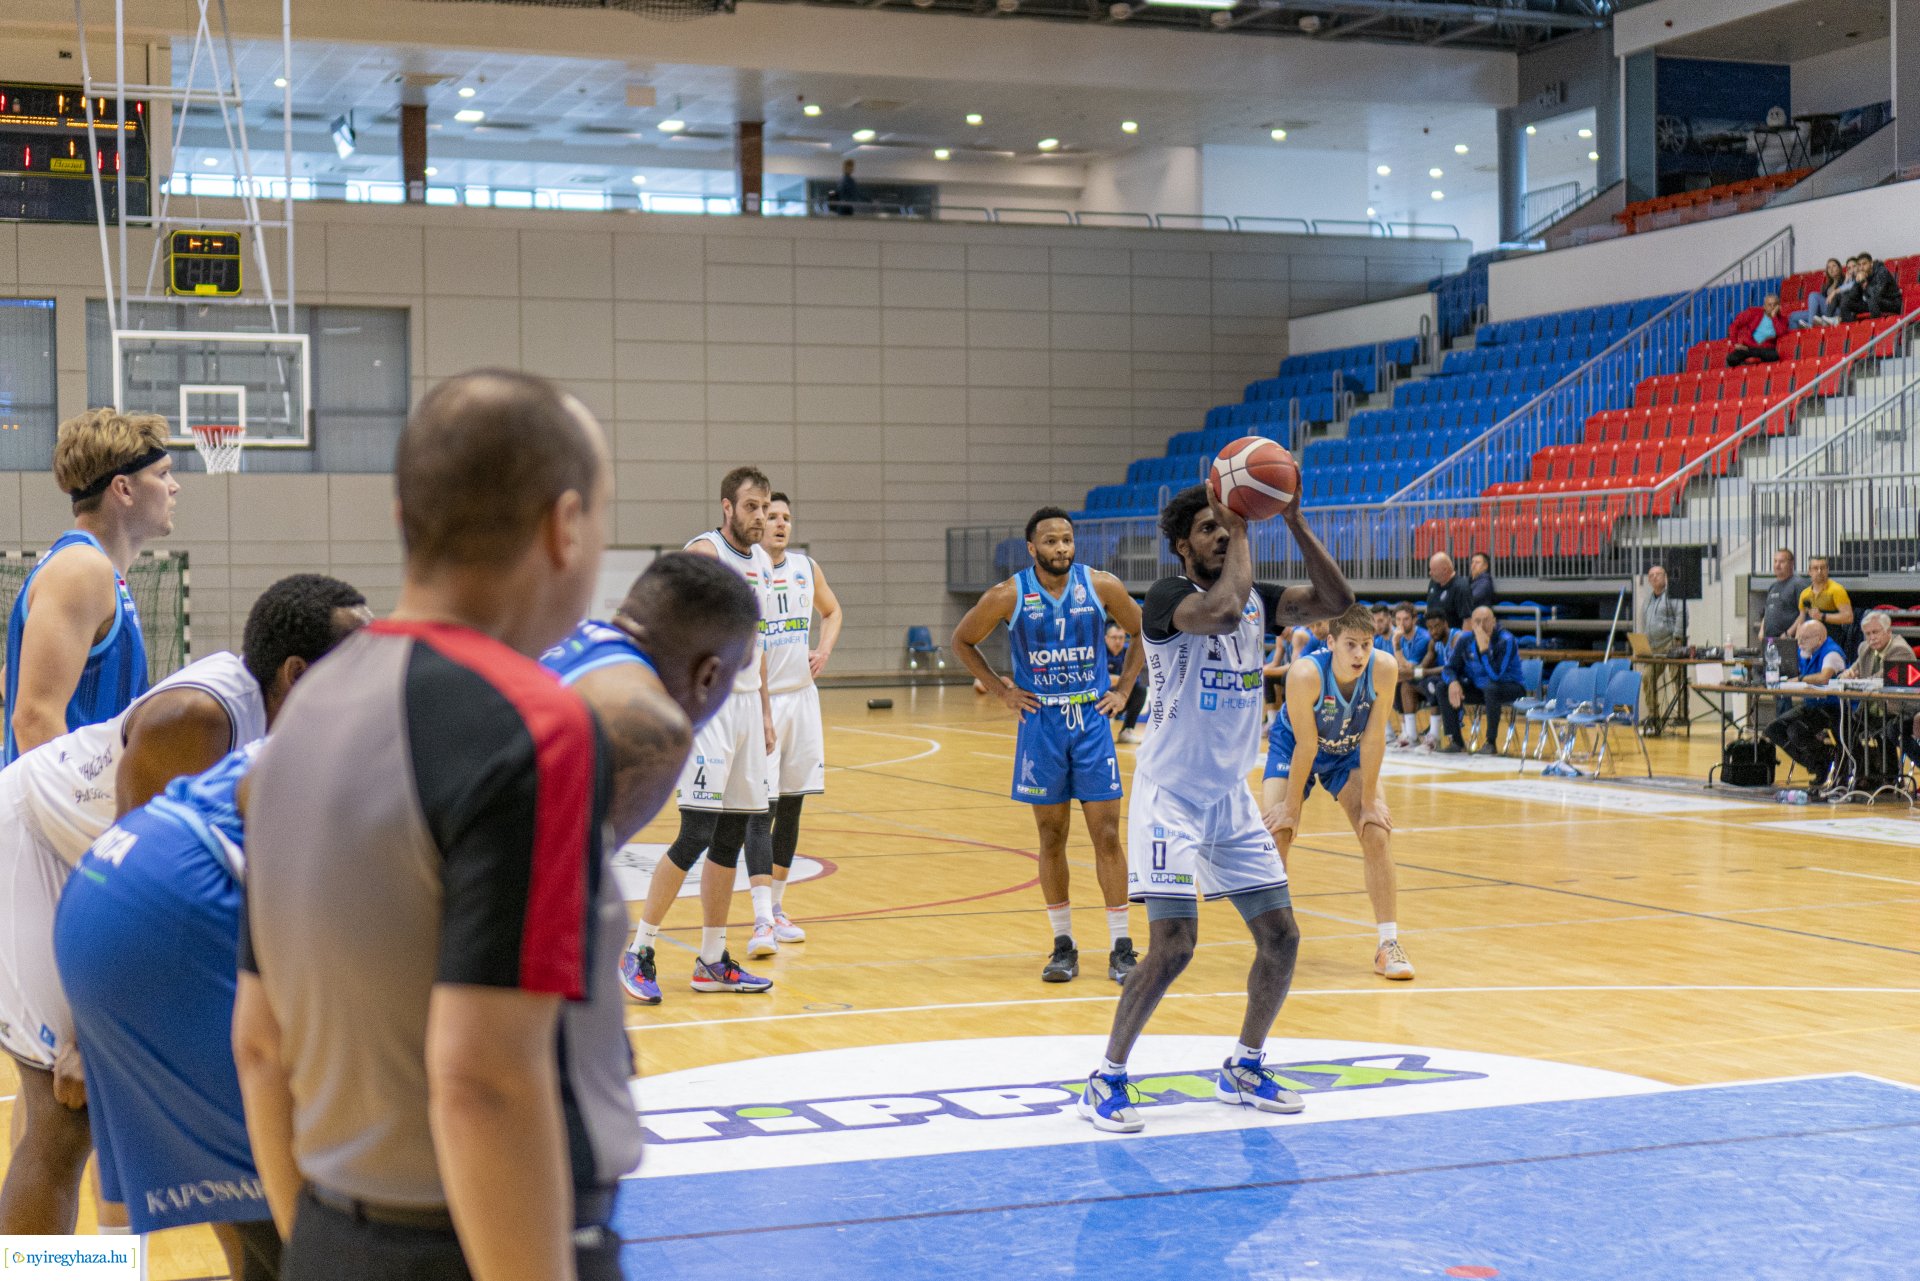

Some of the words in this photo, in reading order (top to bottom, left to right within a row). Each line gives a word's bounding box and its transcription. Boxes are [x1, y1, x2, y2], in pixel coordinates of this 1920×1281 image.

[778, 593, 788, 614] 11
[1055, 617, 1066, 641] 7
[1028, 645, 1095, 666] KOMETA
[694, 766, 706, 789] 4
[1107, 757, 1116, 780] 7
[1152, 841, 1166, 870] 0
